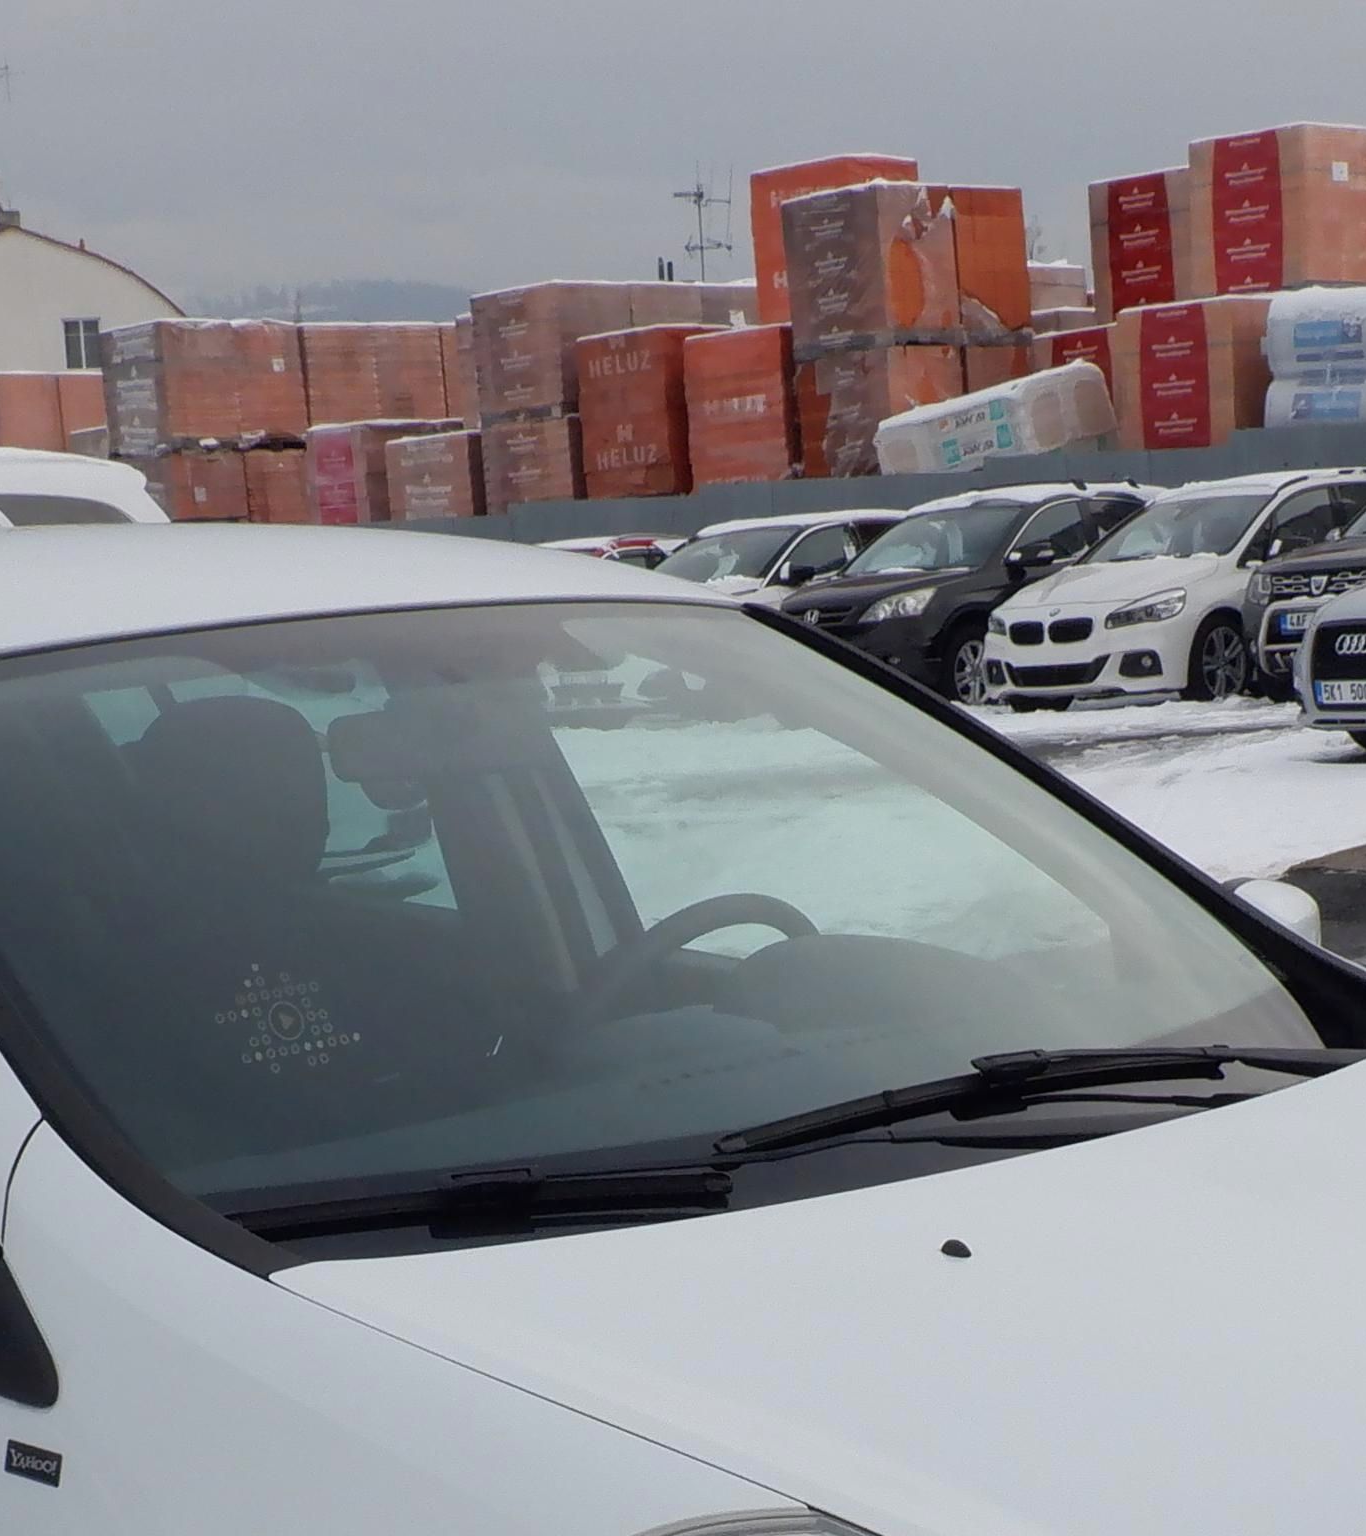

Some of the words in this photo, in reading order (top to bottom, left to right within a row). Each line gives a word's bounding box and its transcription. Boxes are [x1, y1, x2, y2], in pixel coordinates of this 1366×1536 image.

[589, 350, 651, 378] HELUZ
[597, 443, 658, 470] HELUZ
[1323, 684, 1343, 701] 5K1
